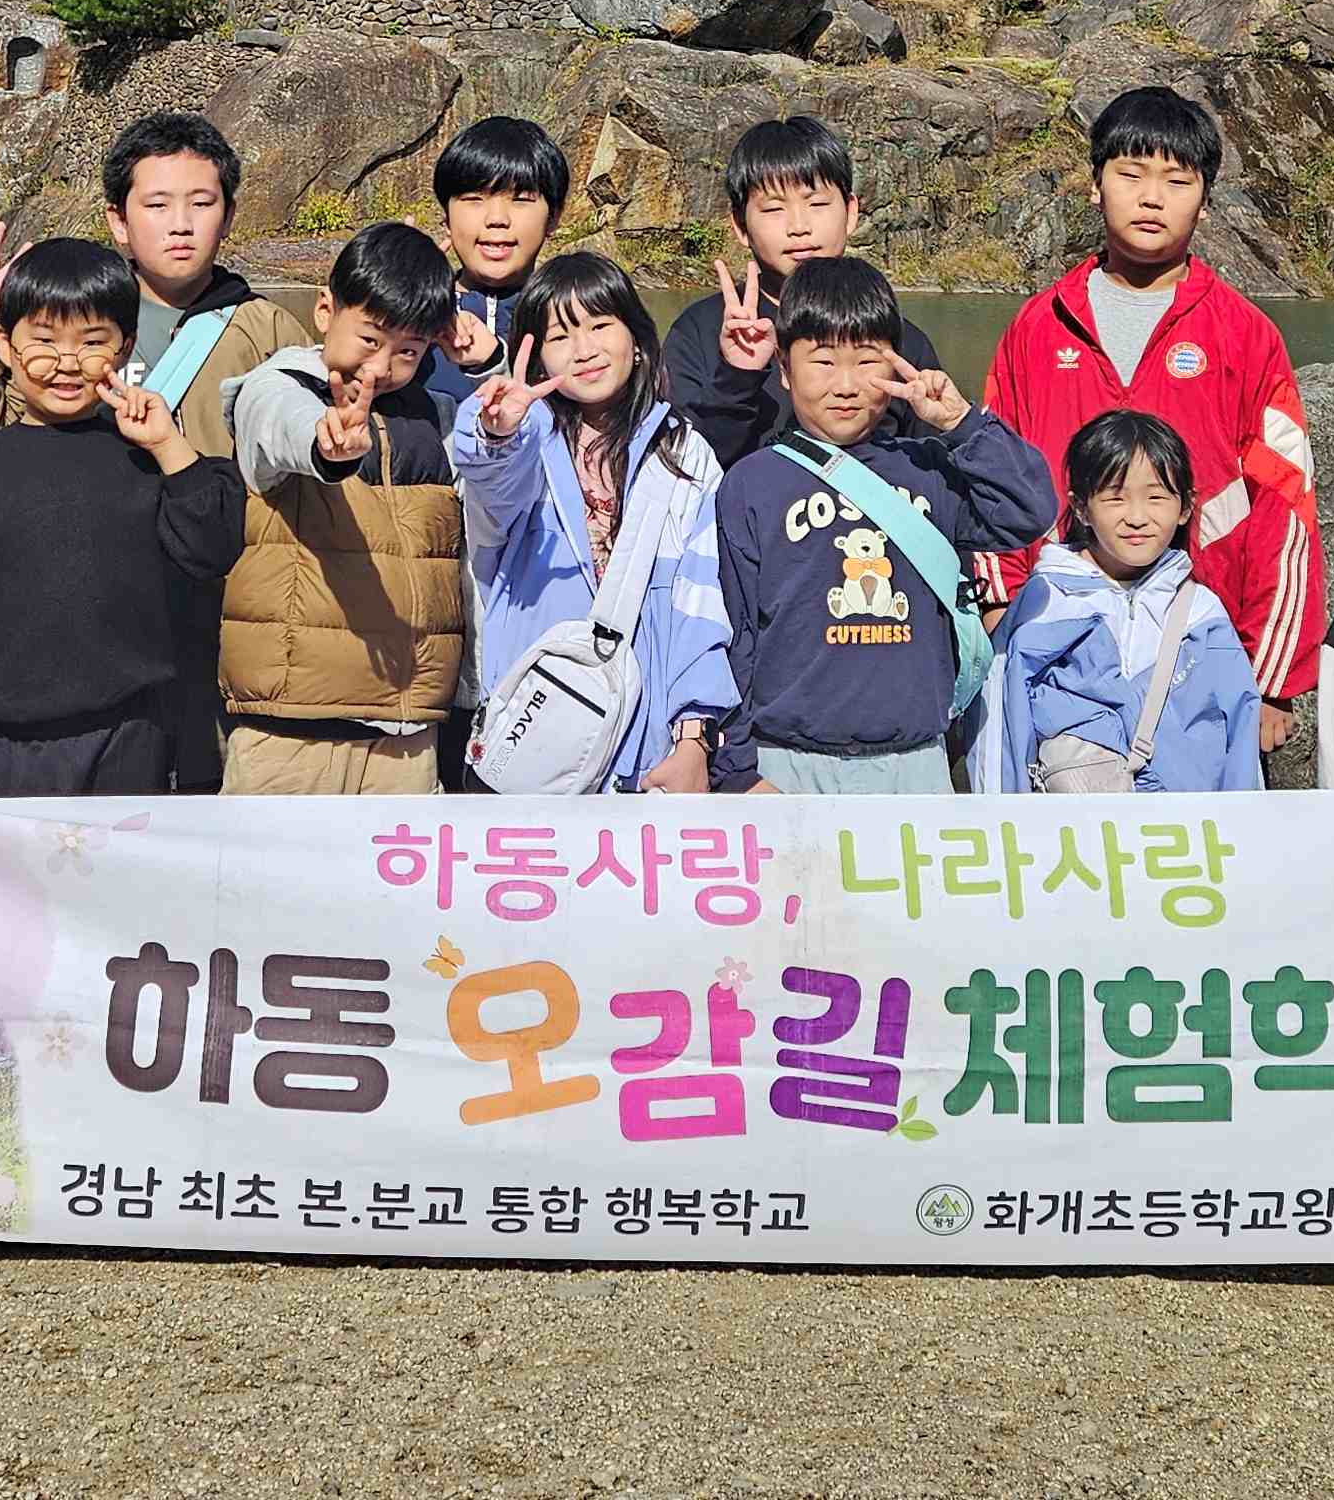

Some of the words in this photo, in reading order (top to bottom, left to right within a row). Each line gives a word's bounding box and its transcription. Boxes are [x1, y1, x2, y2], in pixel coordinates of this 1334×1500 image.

[826, 624, 912, 644] CUTENESS
[373, 823, 801, 926] 하동사랑,
[840, 820, 1234, 928] 나라사랑
[105, 941, 396, 1114] 하동
[445, 959, 912, 1141] 오감길
[60, 1162, 163, 1217] 경남
[178, 1170, 280, 1221] 최초
[297, 1178, 468, 1231] 본.분교
[485, 1185, 589, 1234] 통합
[605, 1187, 809, 1237] 행복학교
